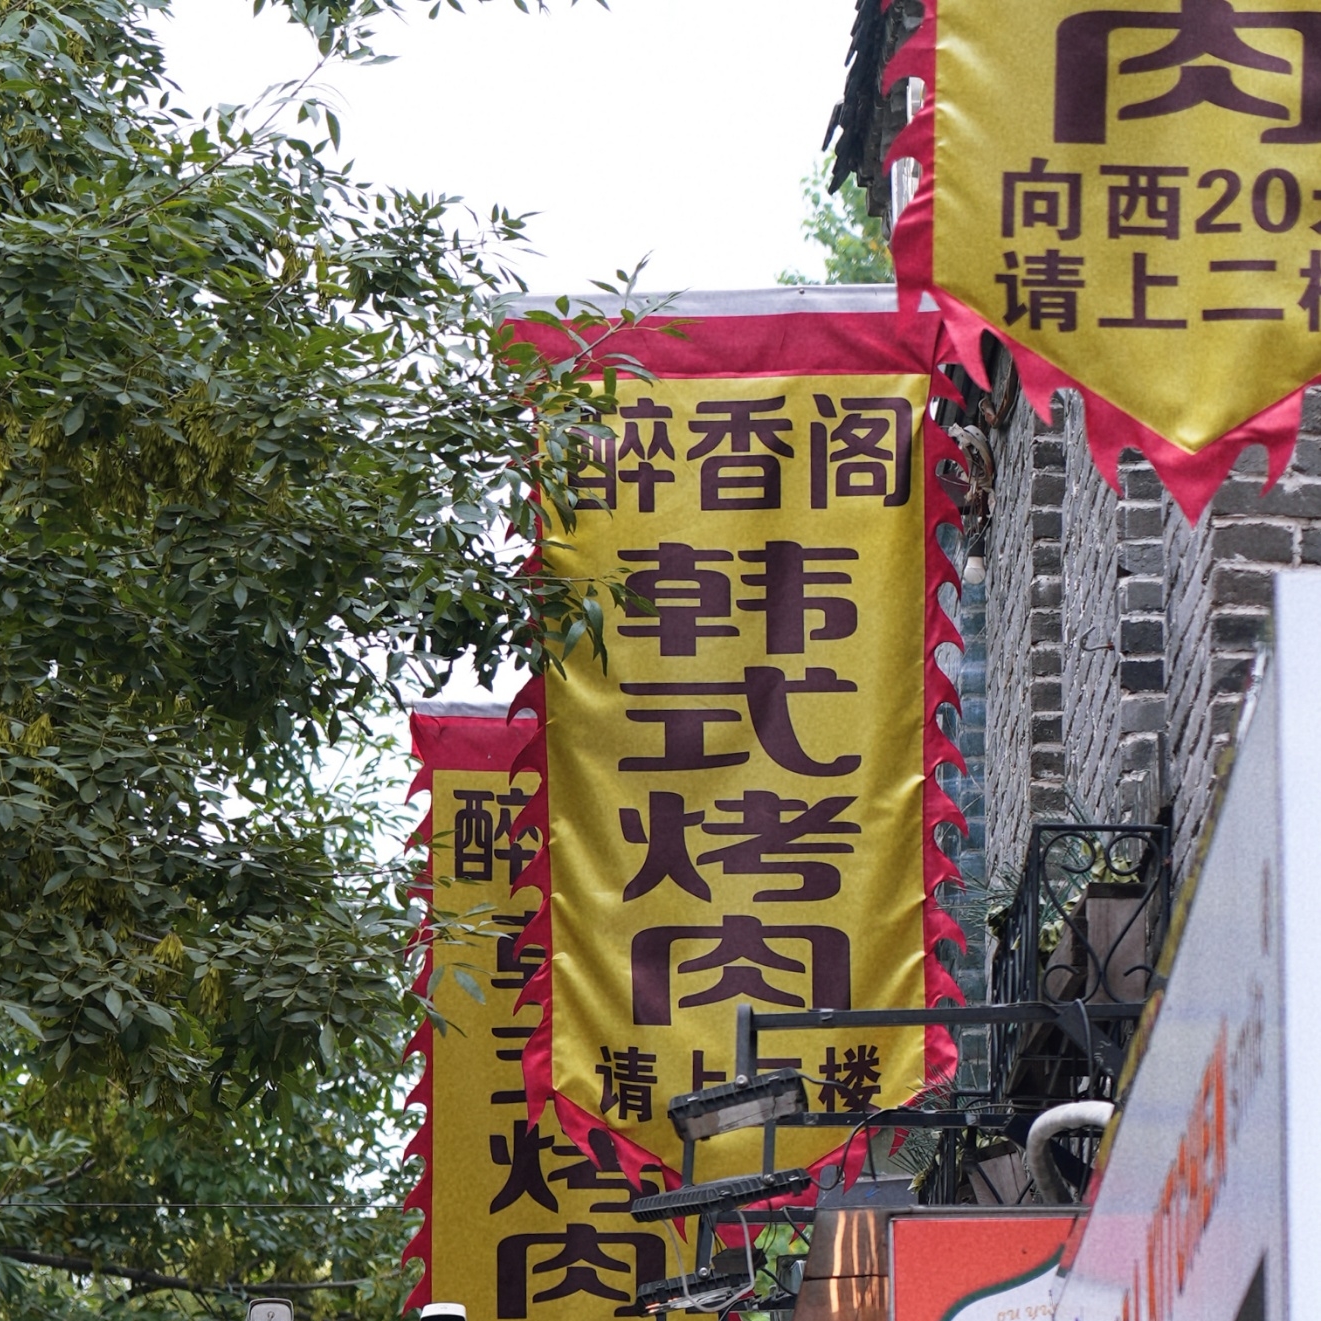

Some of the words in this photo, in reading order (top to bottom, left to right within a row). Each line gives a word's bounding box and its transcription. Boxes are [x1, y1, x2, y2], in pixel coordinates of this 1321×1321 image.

[1001, 157, 1321, 241] 向西20
[564, 395, 912, 514] 醉香阁
[618, 540, 863, 1027] 韩式烤肉
